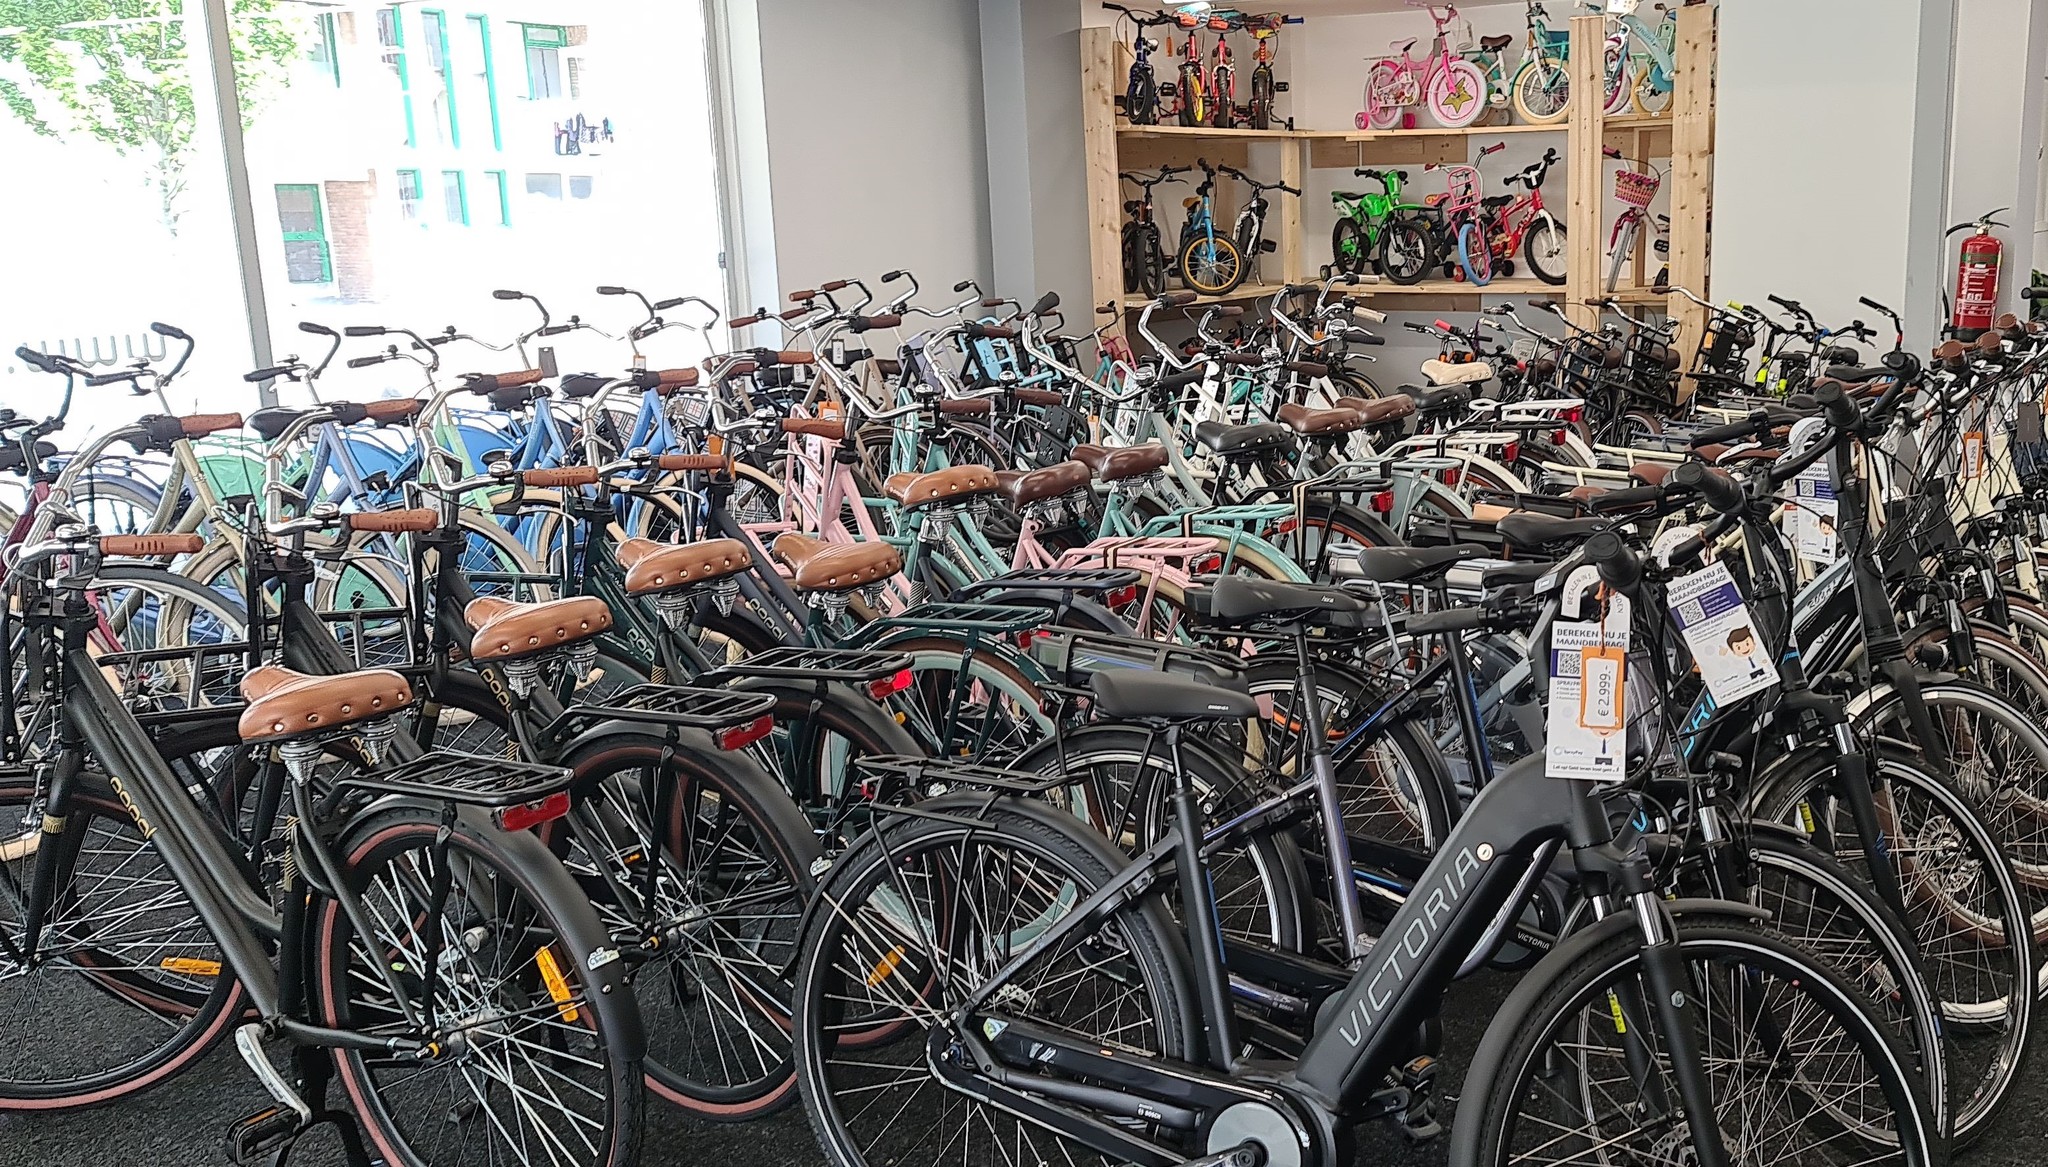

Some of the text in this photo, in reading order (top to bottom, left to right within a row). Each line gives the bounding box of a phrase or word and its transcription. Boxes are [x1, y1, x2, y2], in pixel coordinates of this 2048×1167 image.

[627, 628, 655, 662] pop
[1556, 628, 1599, 638] BEREKEN
[1617, 631, 1627, 640] JE
[480, 668, 511, 714] pop
[1597, 709, 1609, 717] €
[1338, 847, 1480, 1047] VICTORIA
[1517, 932, 1550, 950] VICTORIA
